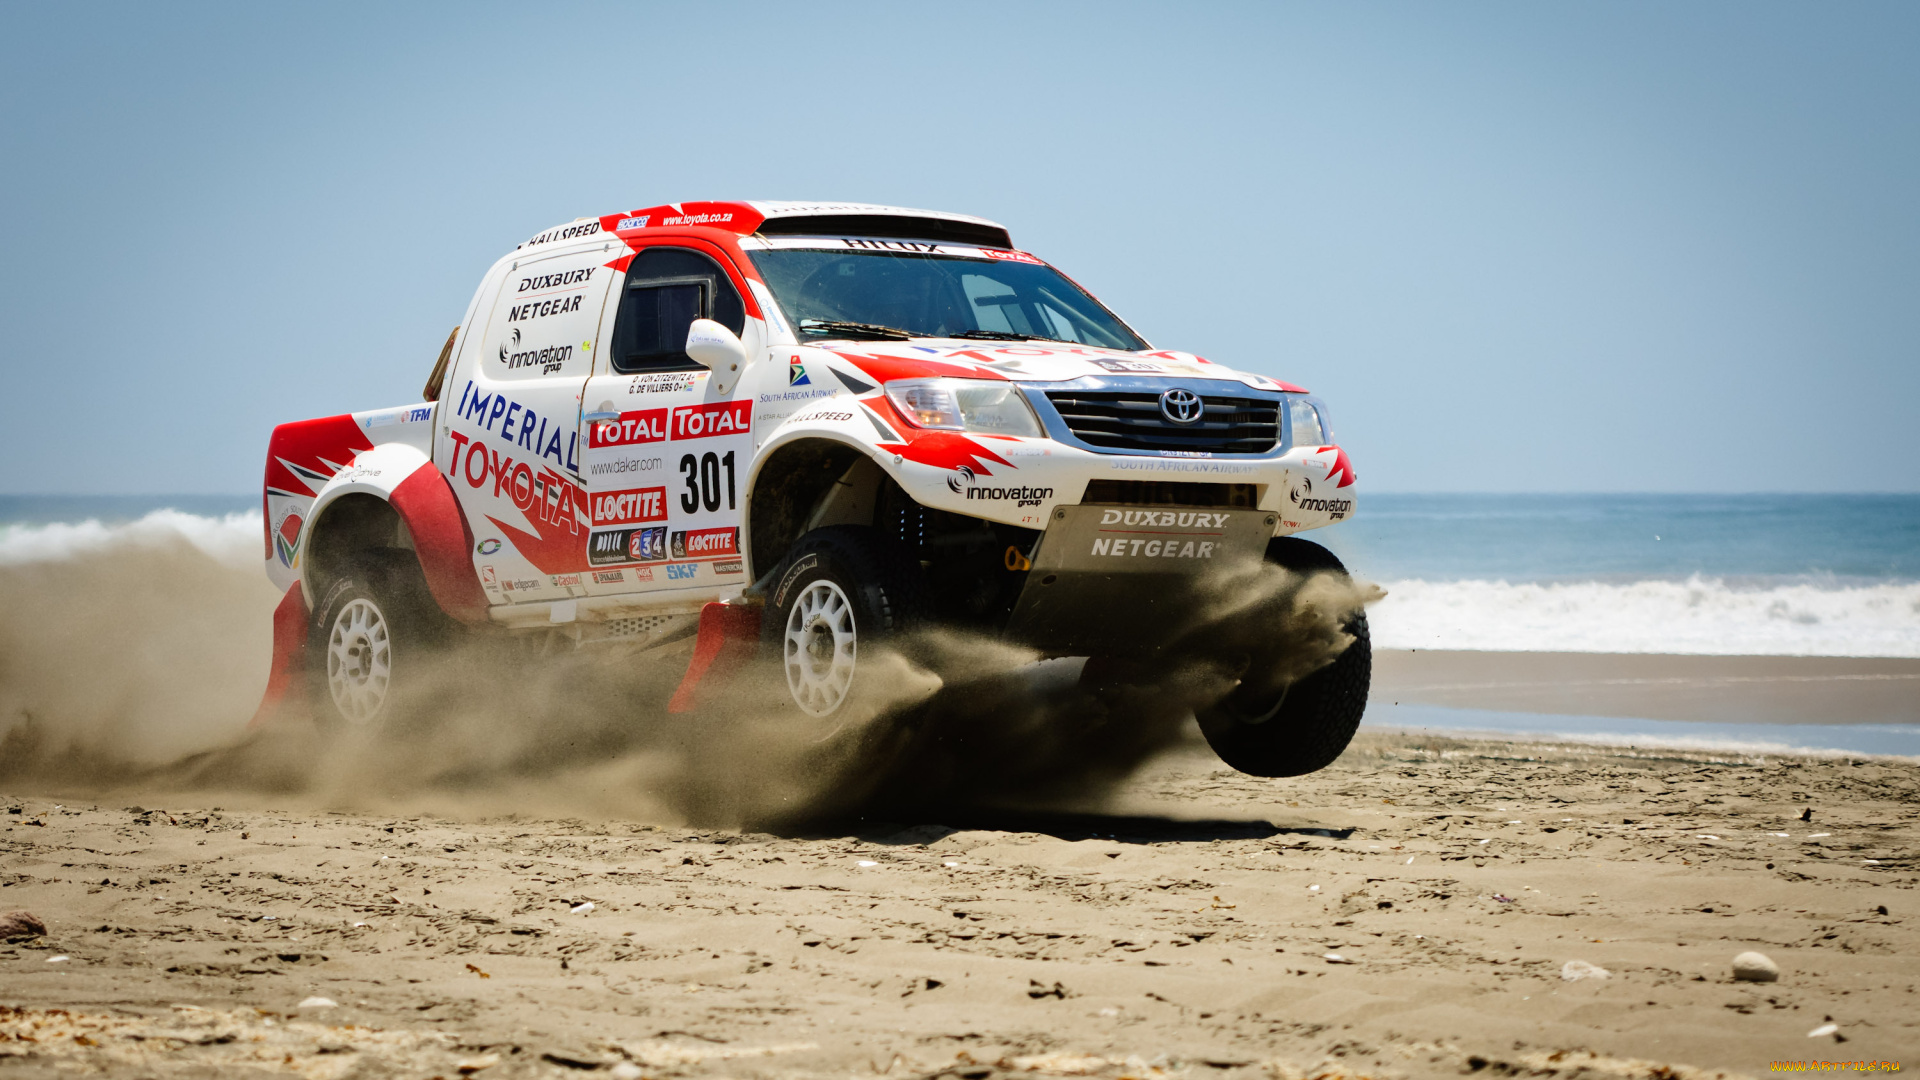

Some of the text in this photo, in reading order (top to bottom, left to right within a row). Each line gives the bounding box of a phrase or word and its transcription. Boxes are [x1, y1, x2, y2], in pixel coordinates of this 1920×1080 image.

[617, 216, 648, 230] sparco
[663, 212, 732, 226] www.toyota.co.za
[528, 222, 599, 247] HALLSPEED
[841, 238, 946, 253] HILUX
[982, 248, 1041, 264] TOTAL
[517, 267, 597, 292] DUXBURY
[508, 295, 583, 322] NETGEAR
[508, 344, 573, 369] innovation
[543, 362, 562, 375] group
[637, 384, 646, 393] DE
[647, 382, 673, 393] VILLIERS
[760, 393, 782, 403] SOUTH
[782, 391, 810, 401] AFRICAN
[410, 407, 432, 422] TFM
[675, 408, 749, 436] TOTAL
[457, 380, 578, 473] IMPERIAL
[591, 457, 662, 475] www.dakar.com
[1111, 460, 1154, 470] SOUTH
[1157, 460, 1209, 473] AFRICAN
[450, 430, 579, 535] TOYOTA
[679, 450, 736, 515] 301
[966, 485, 1053, 499] innovation
[595, 491, 661, 521] LOCTITE
[1018, 499, 1042, 507] group
[1299, 498, 1351, 512] innovation
[1100, 509, 1229, 528] DUXBURY
[632, 538, 640, 555] 2
[642, 537, 652, 554] 3
[653, 536, 661, 553] 4
[688, 532, 732, 551] LOCTITE
[1091, 538, 1214, 559] NETGEAR
[637, 567, 651, 578] NGK
[666, 563, 698, 579] SKF
[558, 574, 580, 586] Castrol
